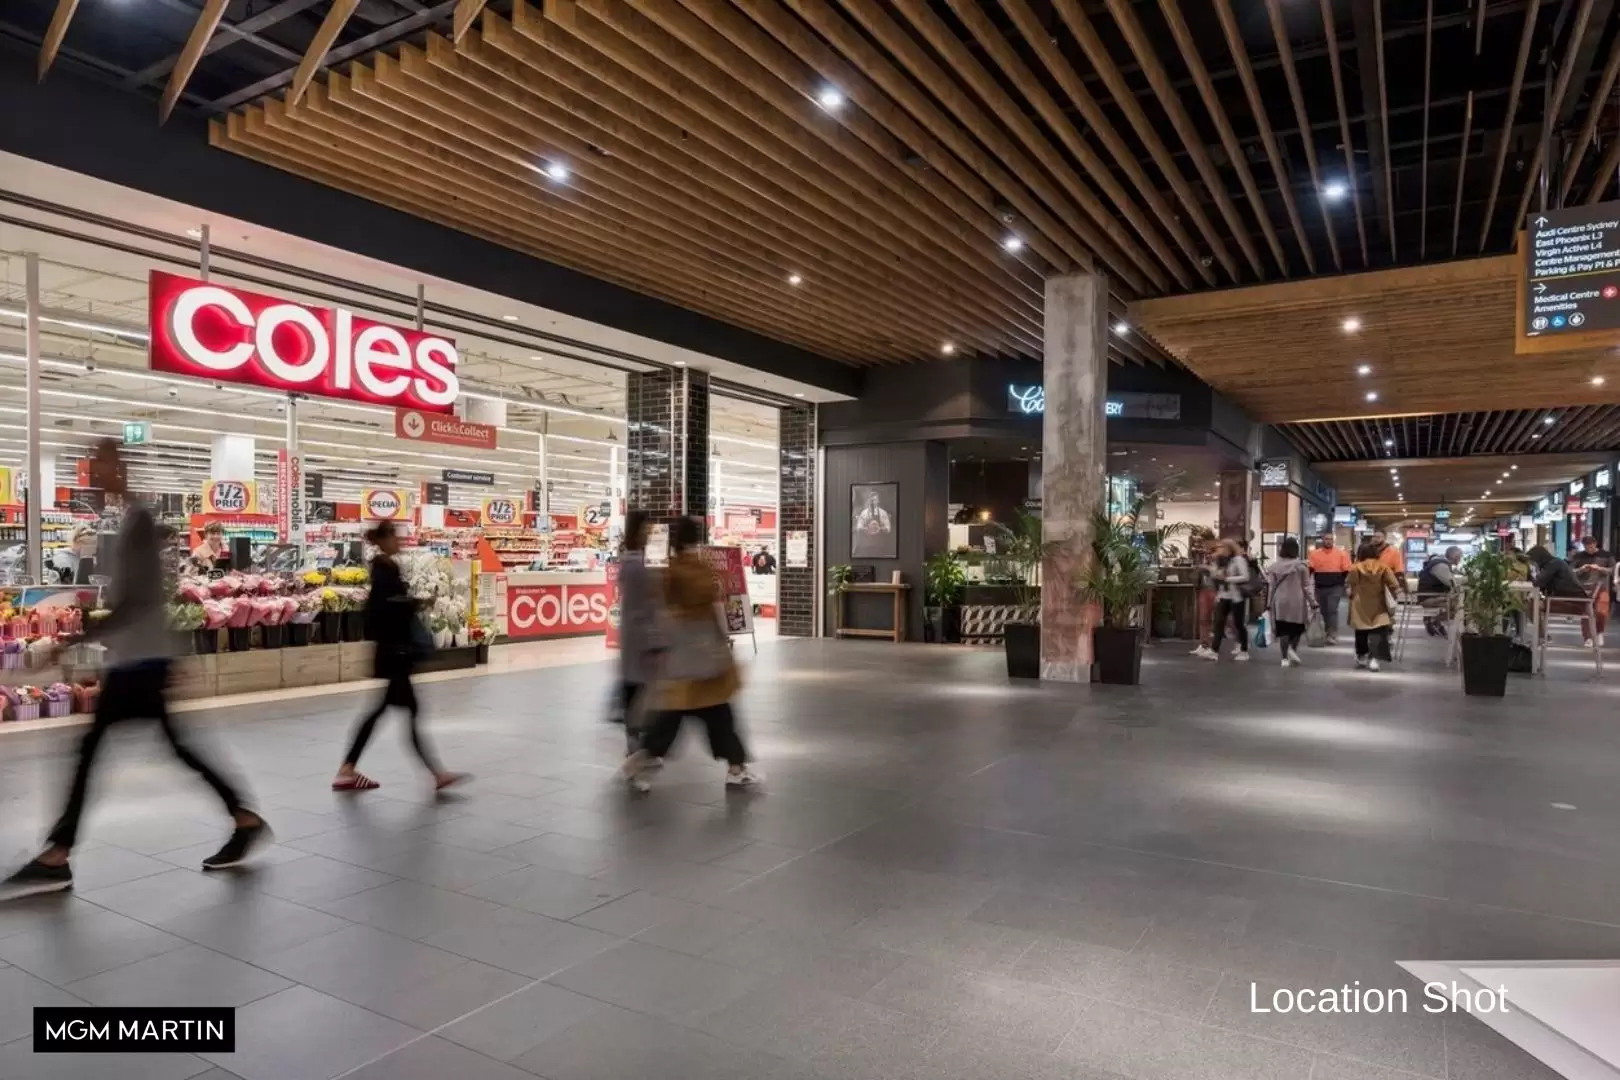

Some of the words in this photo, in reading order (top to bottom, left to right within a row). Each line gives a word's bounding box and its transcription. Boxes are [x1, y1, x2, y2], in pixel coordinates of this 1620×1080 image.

[1535, 229, 1556, 238] Audi
[1557, 226, 1586, 235] Centre
[1586, 220, 1619, 231] Sydney
[1535, 239, 1554, 247] East
[1555, 234, 1591, 245] Phoenix
[1592, 232, 1603, 240] L3
[1535, 248, 1561, 257] Virgin
[1561, 244, 1590, 254] Active
[1591, 241, 1602, 250] L4
[1535, 258, 1563, 266] Centre
[1563, 249, 1620, 263] Management
[1535, 267, 1568, 277] Parking
[1568, 264, 1577, 272] &
[1577, 263, 1594, 272] Pay
[1605, 260, 1614, 268] &
[1534, 293, 1568, 304] Medical
[1569, 290, 1600, 300] Centre
[1533, 303, 1578, 313] Amenities
[173, 286, 460, 406] coles
[1105, 401, 1124, 415] ERY
[216, 482, 243, 500] 1/2
[215, 499, 245, 509] PRICE
[492, 501, 511, 514] 1/2
[511, 584, 608, 629] coles
